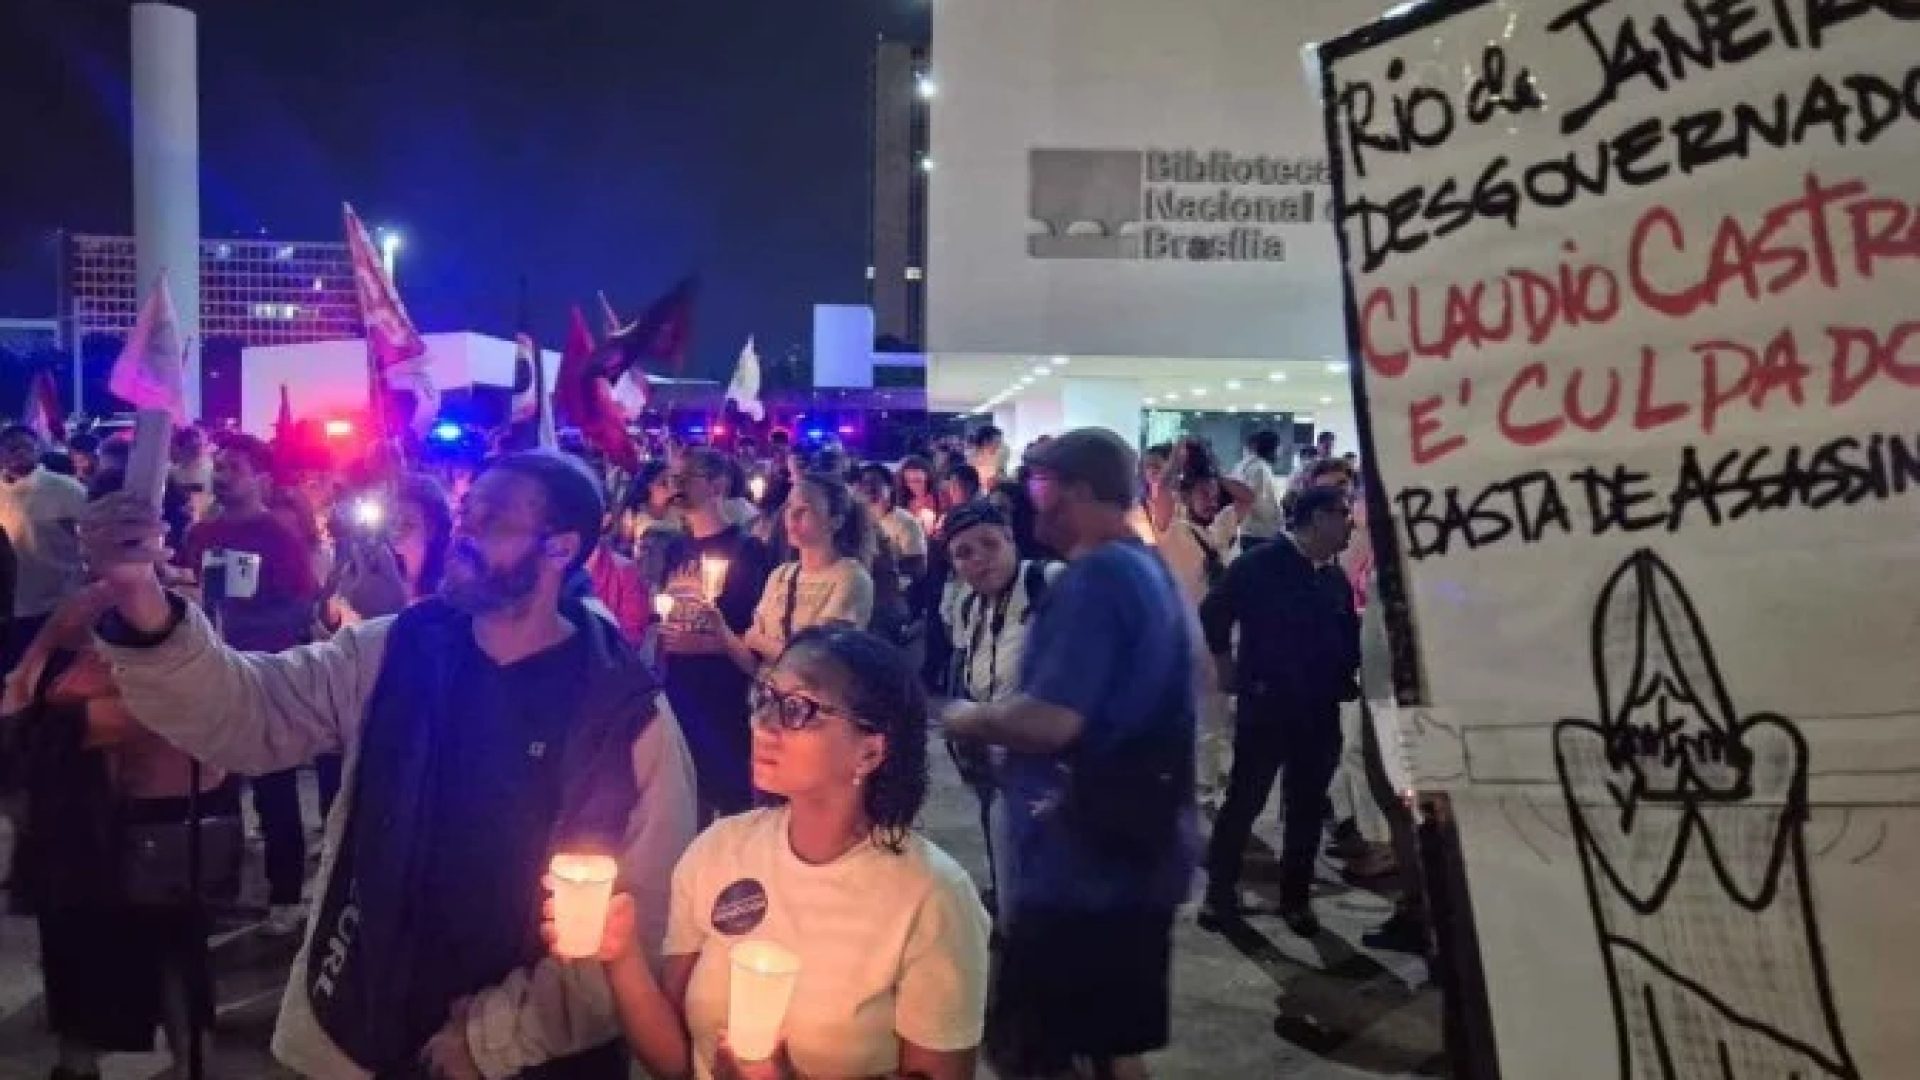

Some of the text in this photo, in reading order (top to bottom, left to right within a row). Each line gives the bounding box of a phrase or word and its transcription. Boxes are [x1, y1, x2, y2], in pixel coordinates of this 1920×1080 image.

[1145, 188, 1314, 223] Nacional
[1629, 173, 1920, 316] CASTR
[1396, 473, 1572, 558] BASTA
[1570, 465, 1667, 534] DE
